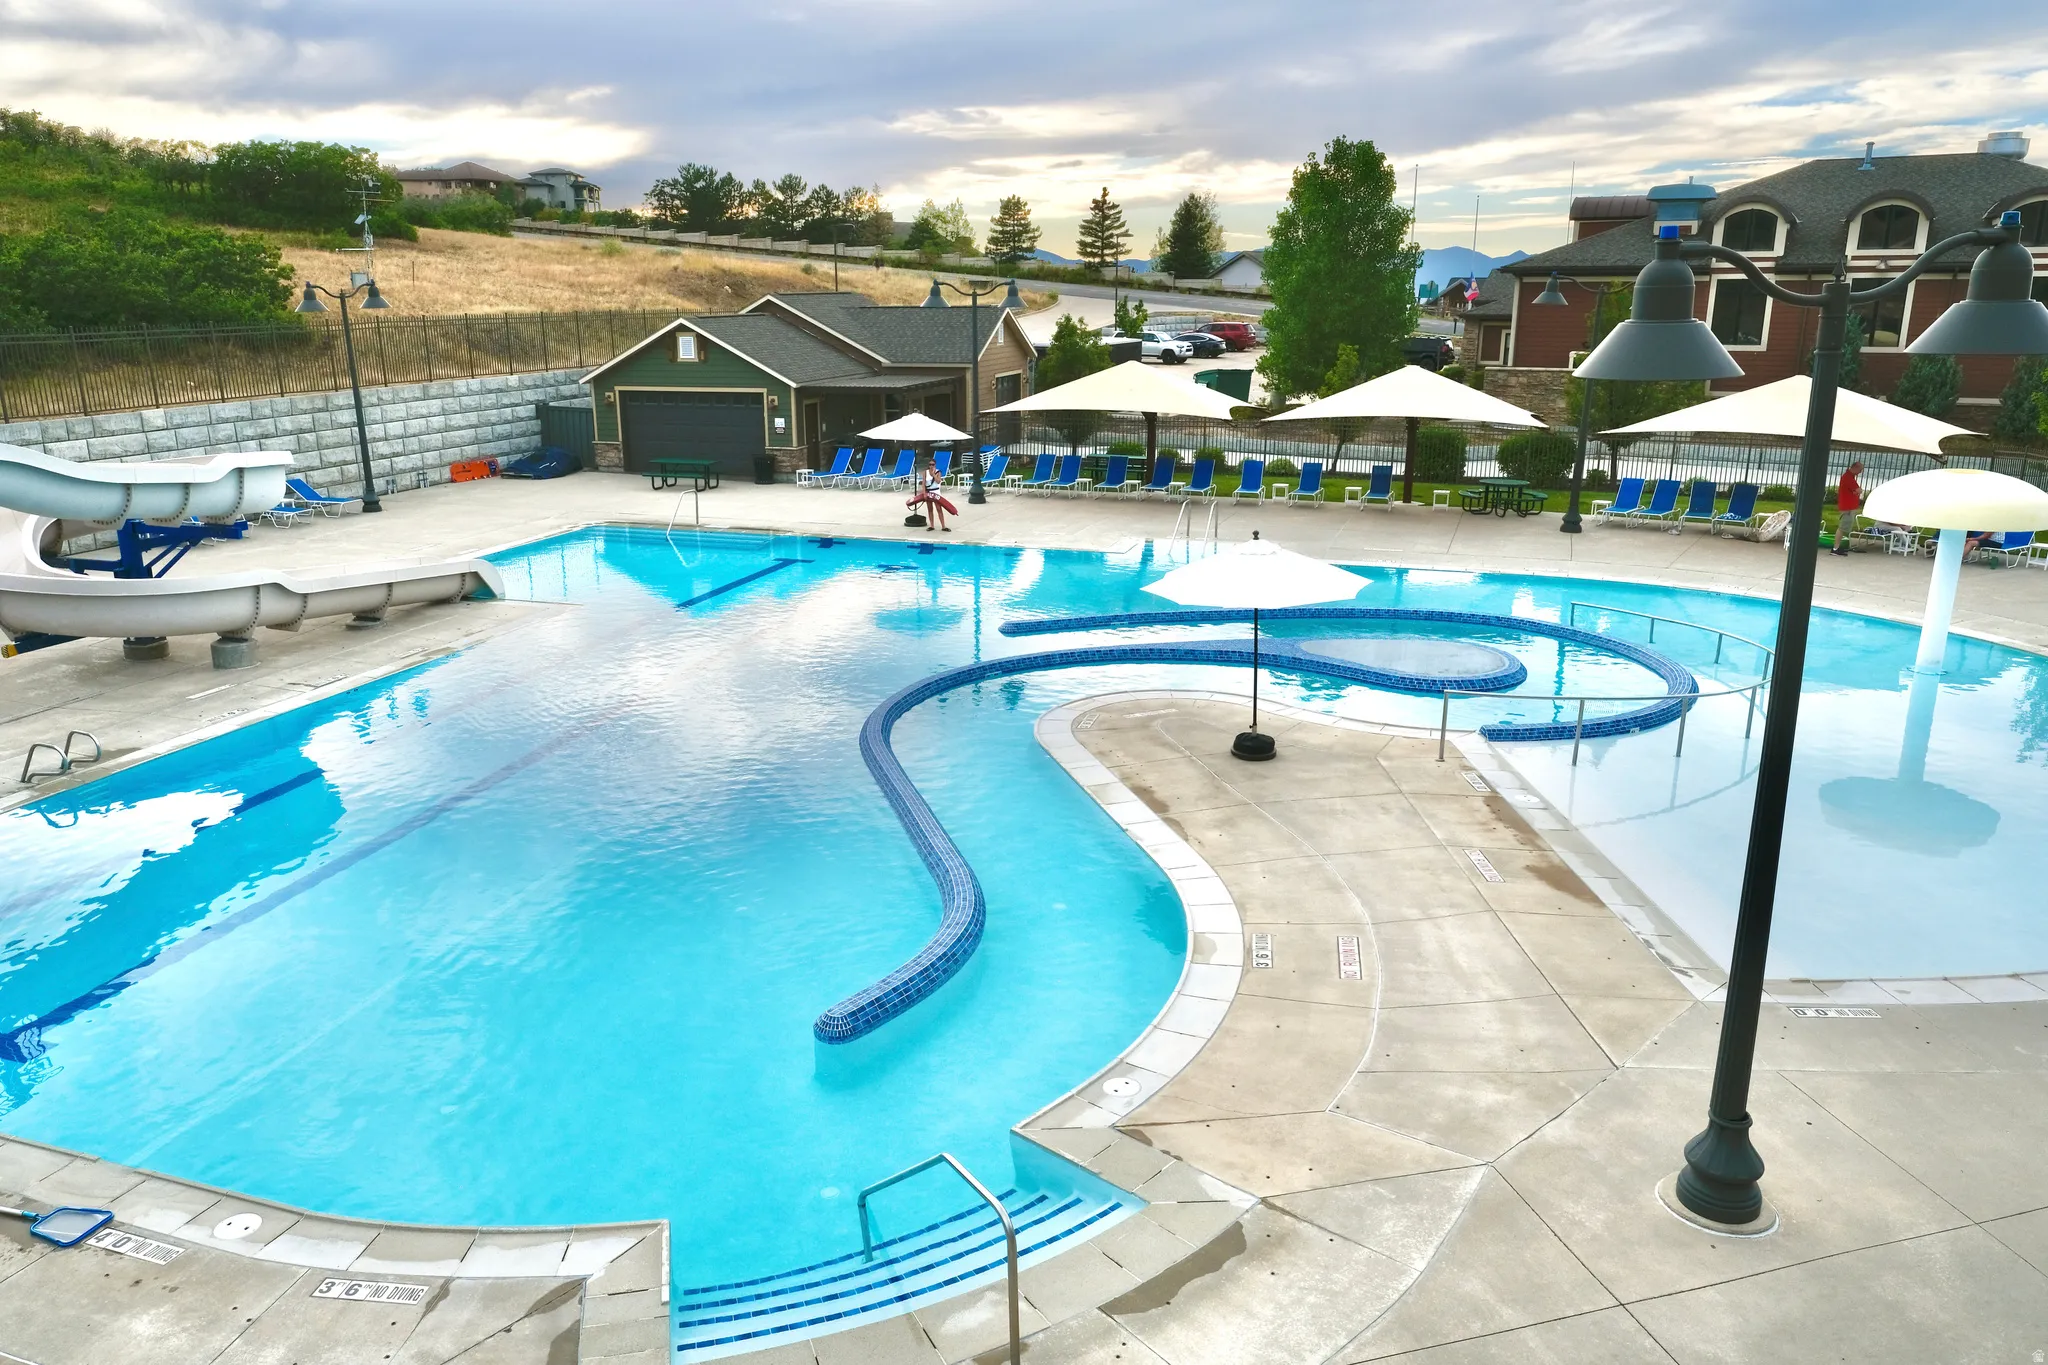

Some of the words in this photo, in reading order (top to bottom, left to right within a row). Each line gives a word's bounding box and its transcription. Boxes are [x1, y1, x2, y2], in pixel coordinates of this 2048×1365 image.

[93, 1232, 113, 1243] 4
[111, 1236, 132, 1249] 0
[130, 1241, 152, 1254] NO
[143, 1244, 180, 1262] DIVING
[318, 1281, 336, 1294] 3
[344, 1283, 362, 1296] 6
[369, 1284, 389, 1299] NO
[386, 1286, 425, 1302] DIVING
